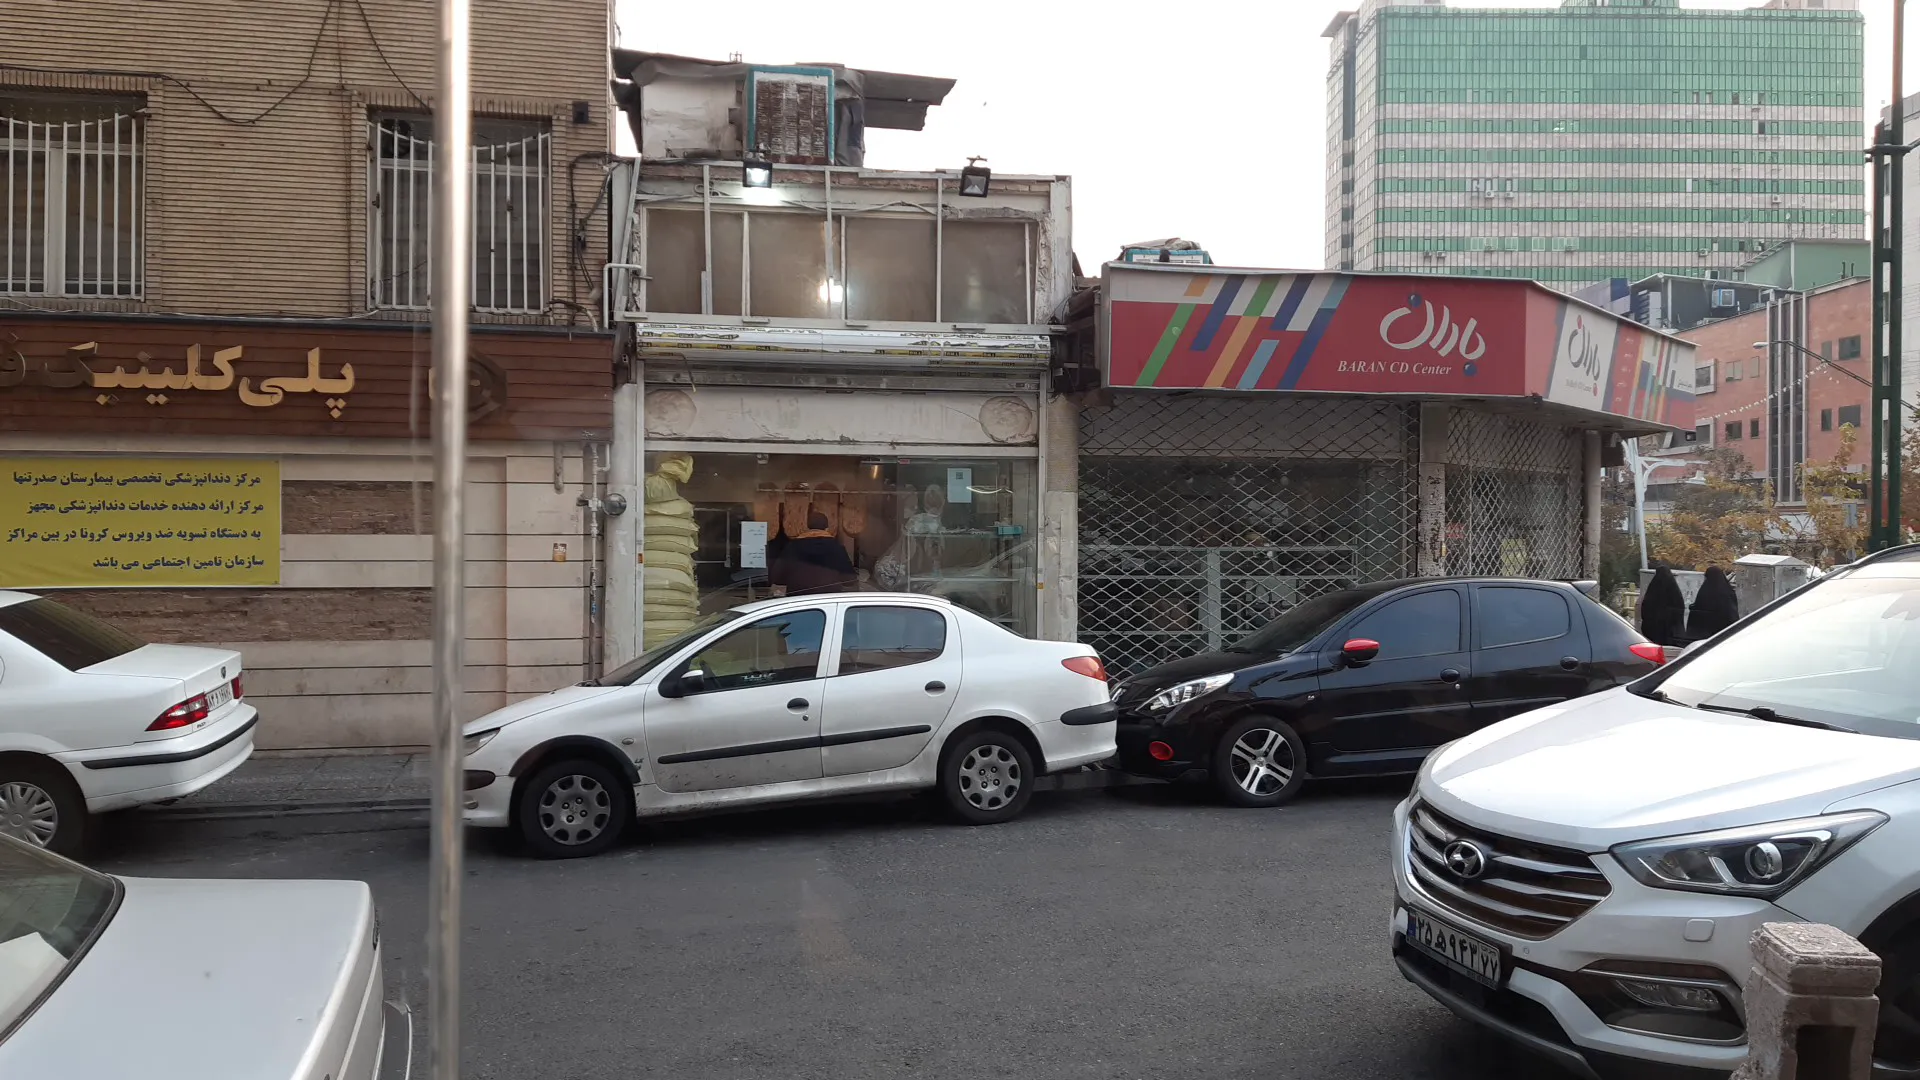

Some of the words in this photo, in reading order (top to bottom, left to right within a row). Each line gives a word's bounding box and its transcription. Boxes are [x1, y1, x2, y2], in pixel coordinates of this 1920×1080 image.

[44, 341, 244, 406] کلینیک
[1337, 360, 1388, 374] BARAN
[1389, 361, 1410, 374] CD
[1412, 362, 1453, 376] Center
[238, 346, 356, 420] پلی
[60, 471, 113, 487] بیمارستان
[116, 472, 162, 487] تخصصی
[164, 472, 231, 487] دندانپزشکی
[233, 472, 261, 487] مرکز
[26, 501, 56, 514] مجهز
[58, 499, 126, 514] دندانپزشکی
[128, 499, 169, 511] خدمات
[171, 500, 206, 511] دهنده
[208, 498, 234, 514] ارائه
[237, 499, 264, 514] مرکز
[6, 527, 38, 542] مراکز
[41, 530, 60, 542] بین
[63, 529, 77, 542] در
[79, 527, 110, 542] کرونا
[111, 530, 152, 542] ویروس
[155, 527, 174, 539] ضد
[176, 527, 207, 542] تسویه
[210, 527, 248, 539] دستگاه
[250, 529, 261, 541] به
[92, 556, 118, 570] باشد
[121, 560, 139, 570] می
[142, 556, 191, 570] اجتماعی
[193, 555, 222, 570] تامین
[224, 555, 265, 570] سازمان
